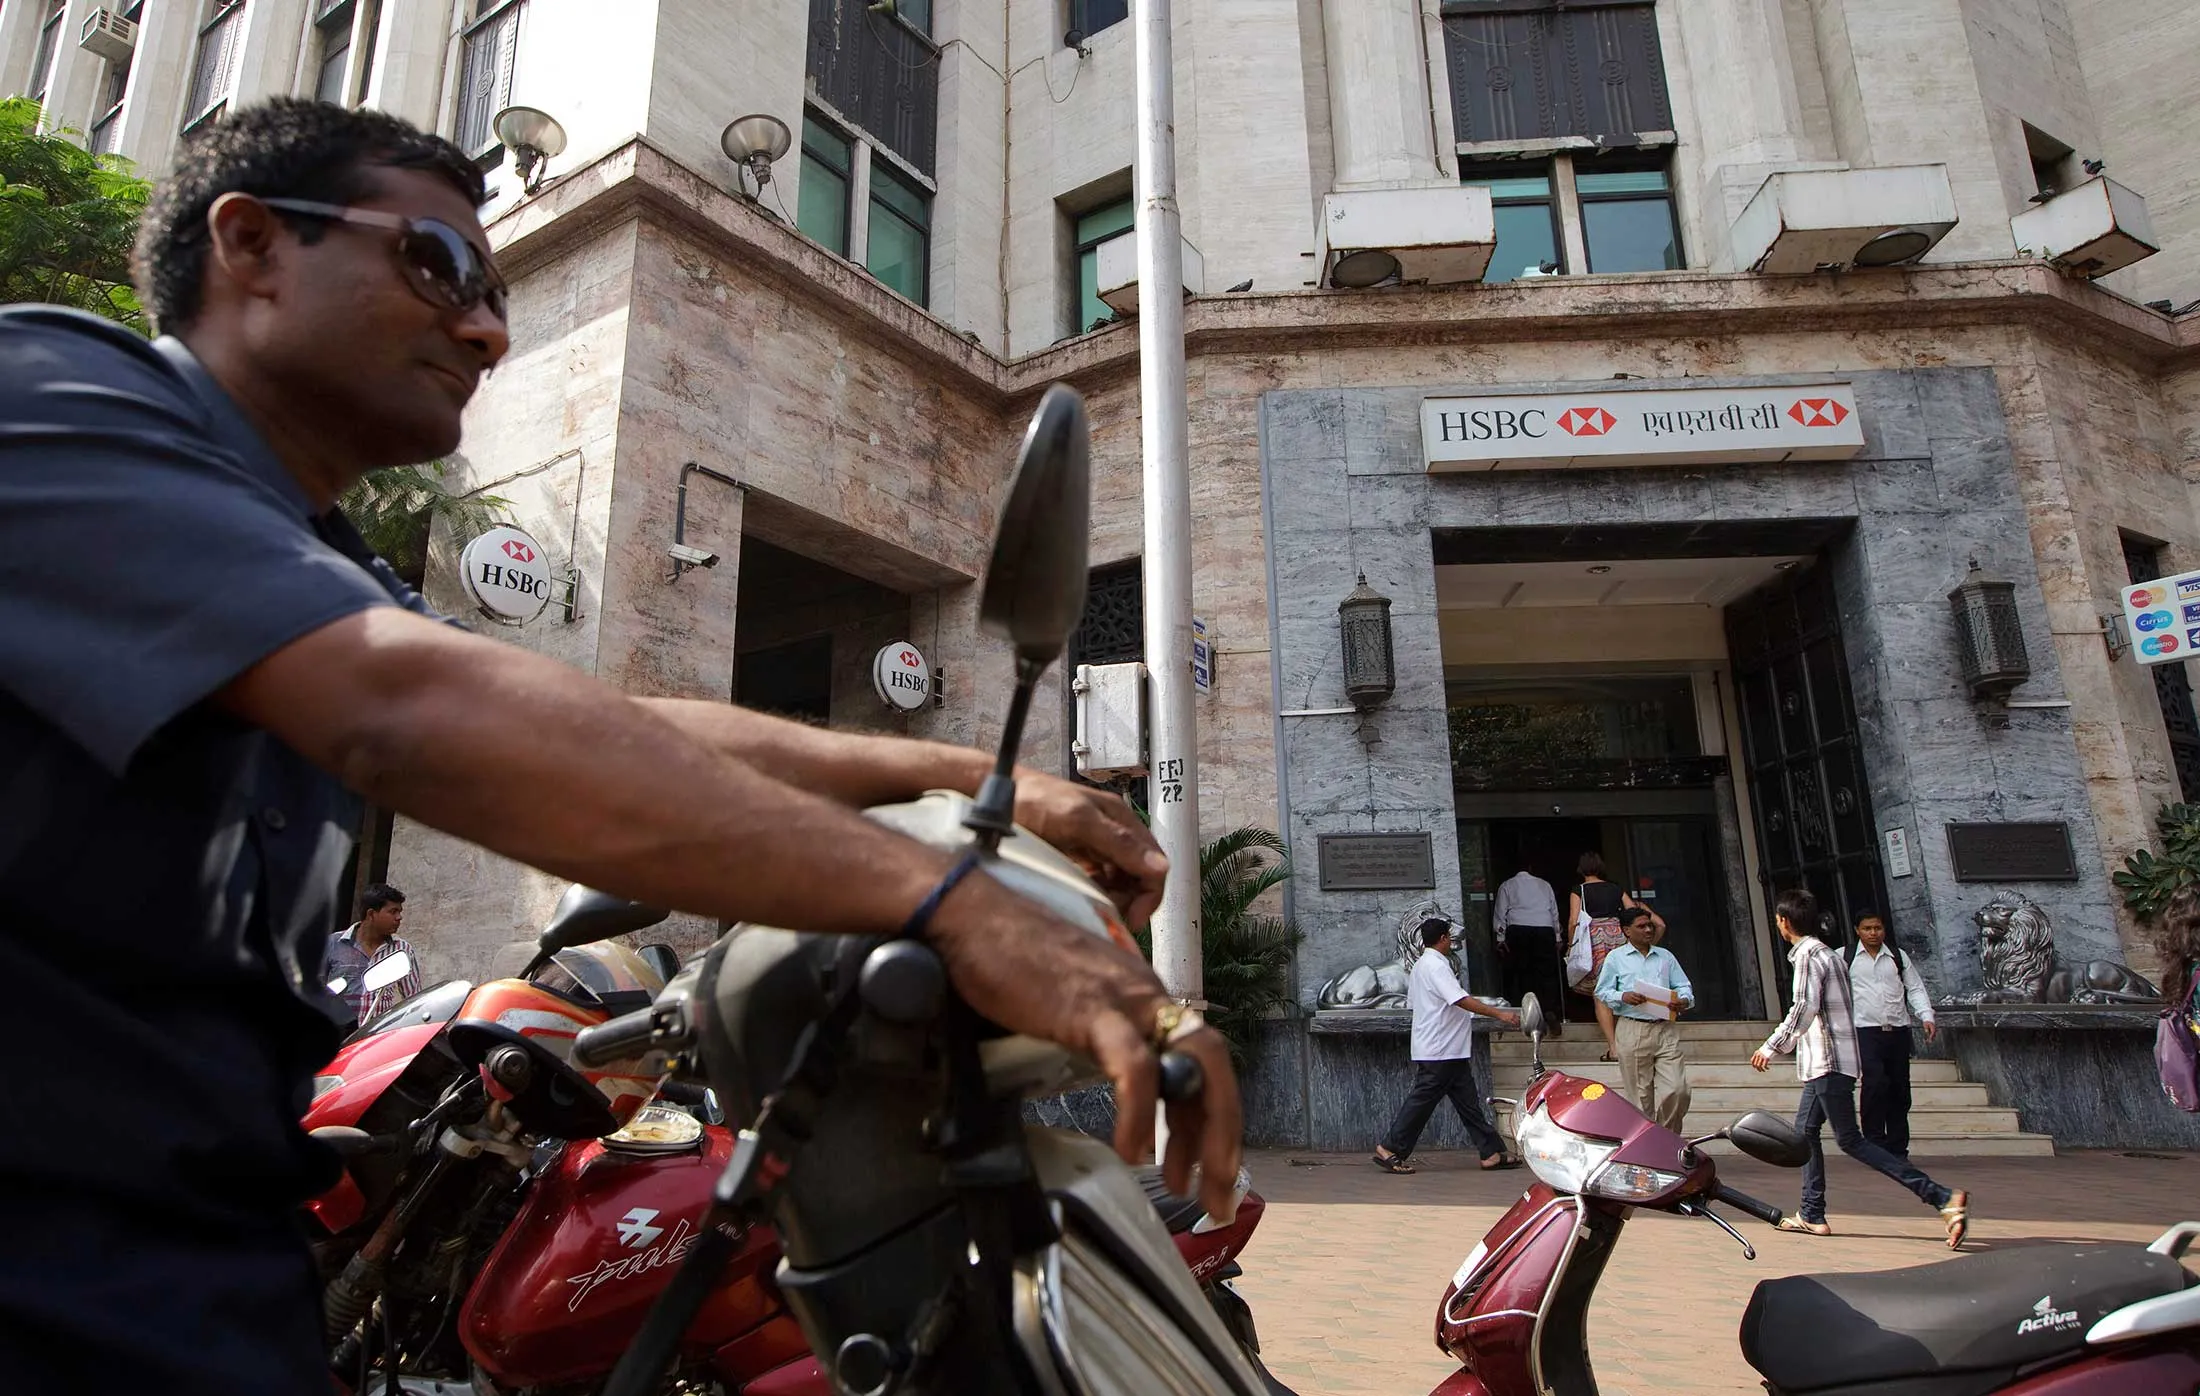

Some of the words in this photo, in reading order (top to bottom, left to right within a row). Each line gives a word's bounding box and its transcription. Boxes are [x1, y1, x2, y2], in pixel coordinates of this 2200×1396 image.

[1440, 409, 1547, 442] HSBC
[481, 563, 548, 601] HSBC
[891, 670, 929, 695] HSBC
[2017, 1311, 2078, 1335] Activa
